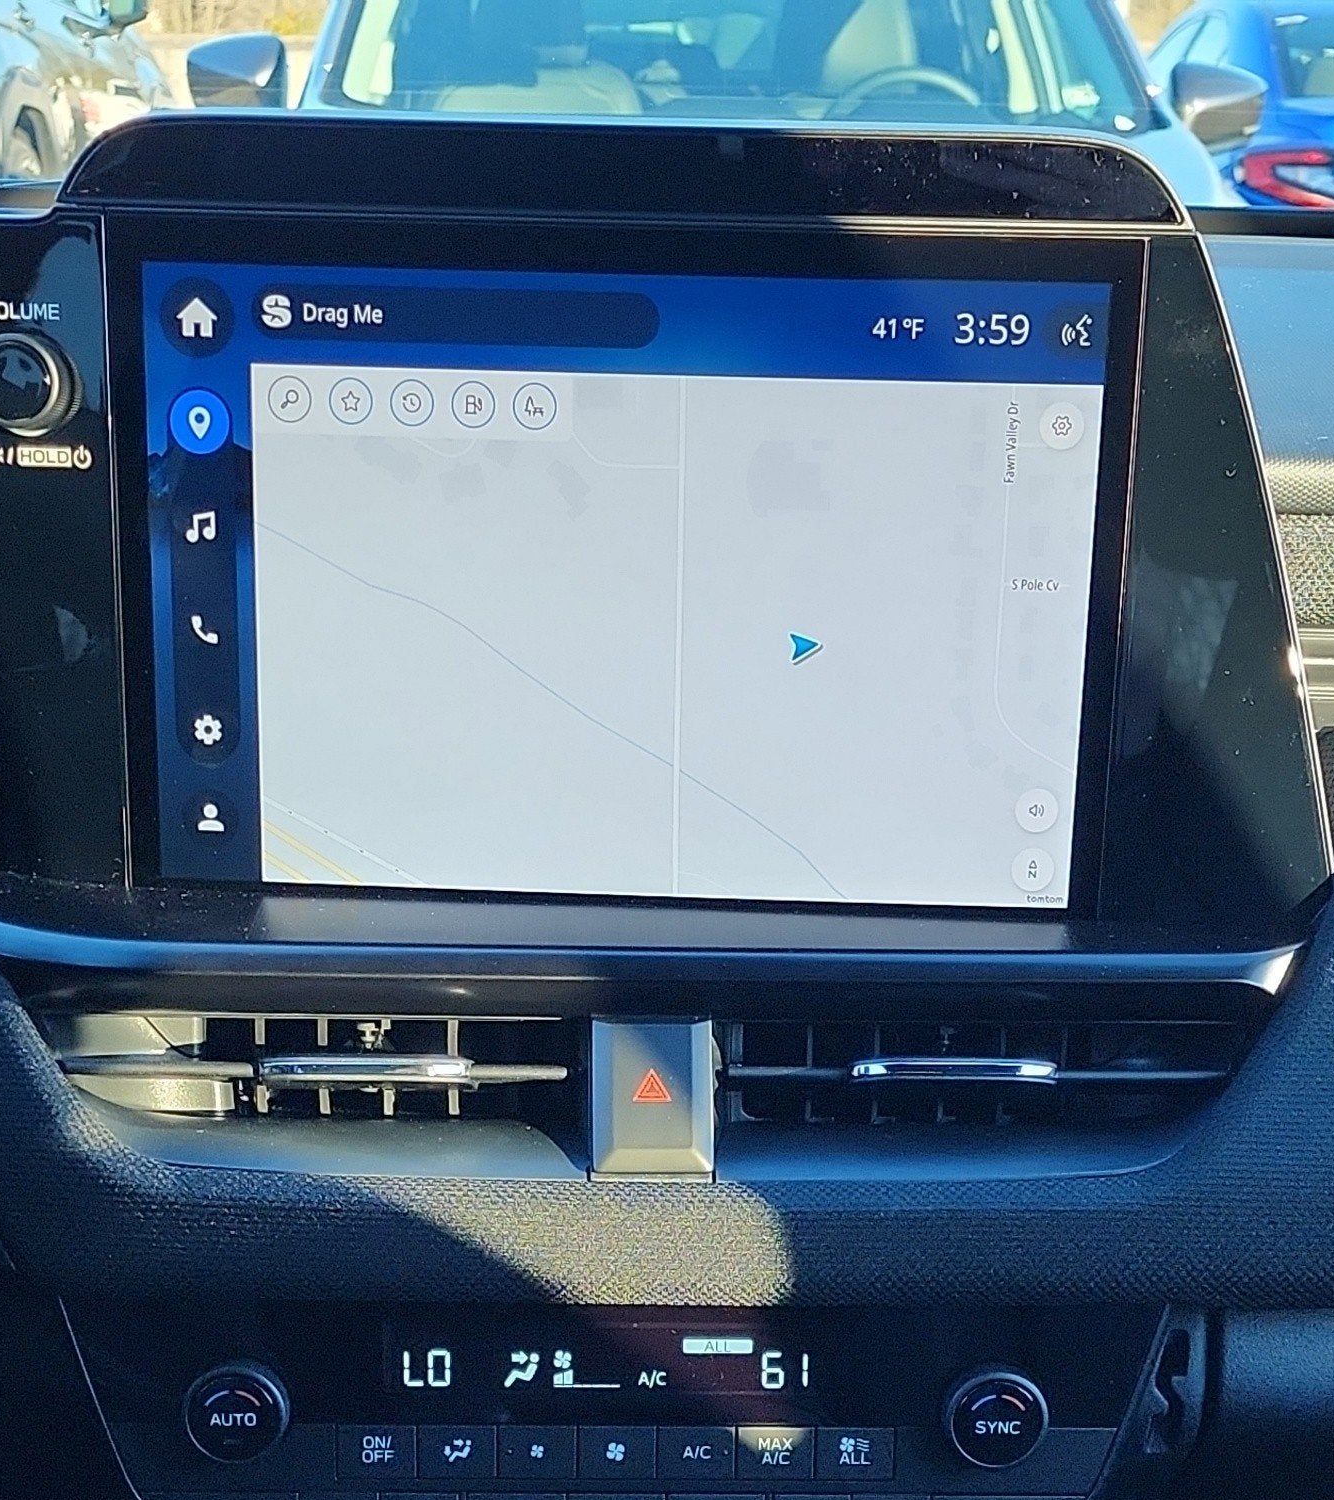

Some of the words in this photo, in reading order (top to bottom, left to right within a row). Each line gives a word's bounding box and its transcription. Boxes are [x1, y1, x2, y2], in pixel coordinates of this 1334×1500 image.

[303, 303, 348, 328] Drag
[353, 304, 383, 324] Me
[954, 313, 1030, 346] 3:59
[1008, 401, 1019, 414] Dr
[1006, 416, 1021, 451] Valley
[20, 450, 69, 465] HOLD
[1004, 454, 1015, 484] Fawn
[1012, 579, 1018, 590] S
[1021, 579, 1043, 591] Pole
[1046, 579, 1060, 591] Cv
[704, 1339, 731, 1353] ALL
[403, 1348, 451, 1388] LO
[761, 1351, 808, 1389] 61
[638, 1370, 667, 1387] A/C
[210, 1412, 257, 1427] AUTO
[975, 1420, 1021, 1435] SYNC
[362, 1435, 392, 1449] ON/
[758, 1437, 793, 1451] MAX
[362, 1449, 395, 1463] OFF
[682, 1445, 711, 1460] A/C
[761, 1451, 791, 1466] A/C
[839, 1451, 871, 1466] ALL
